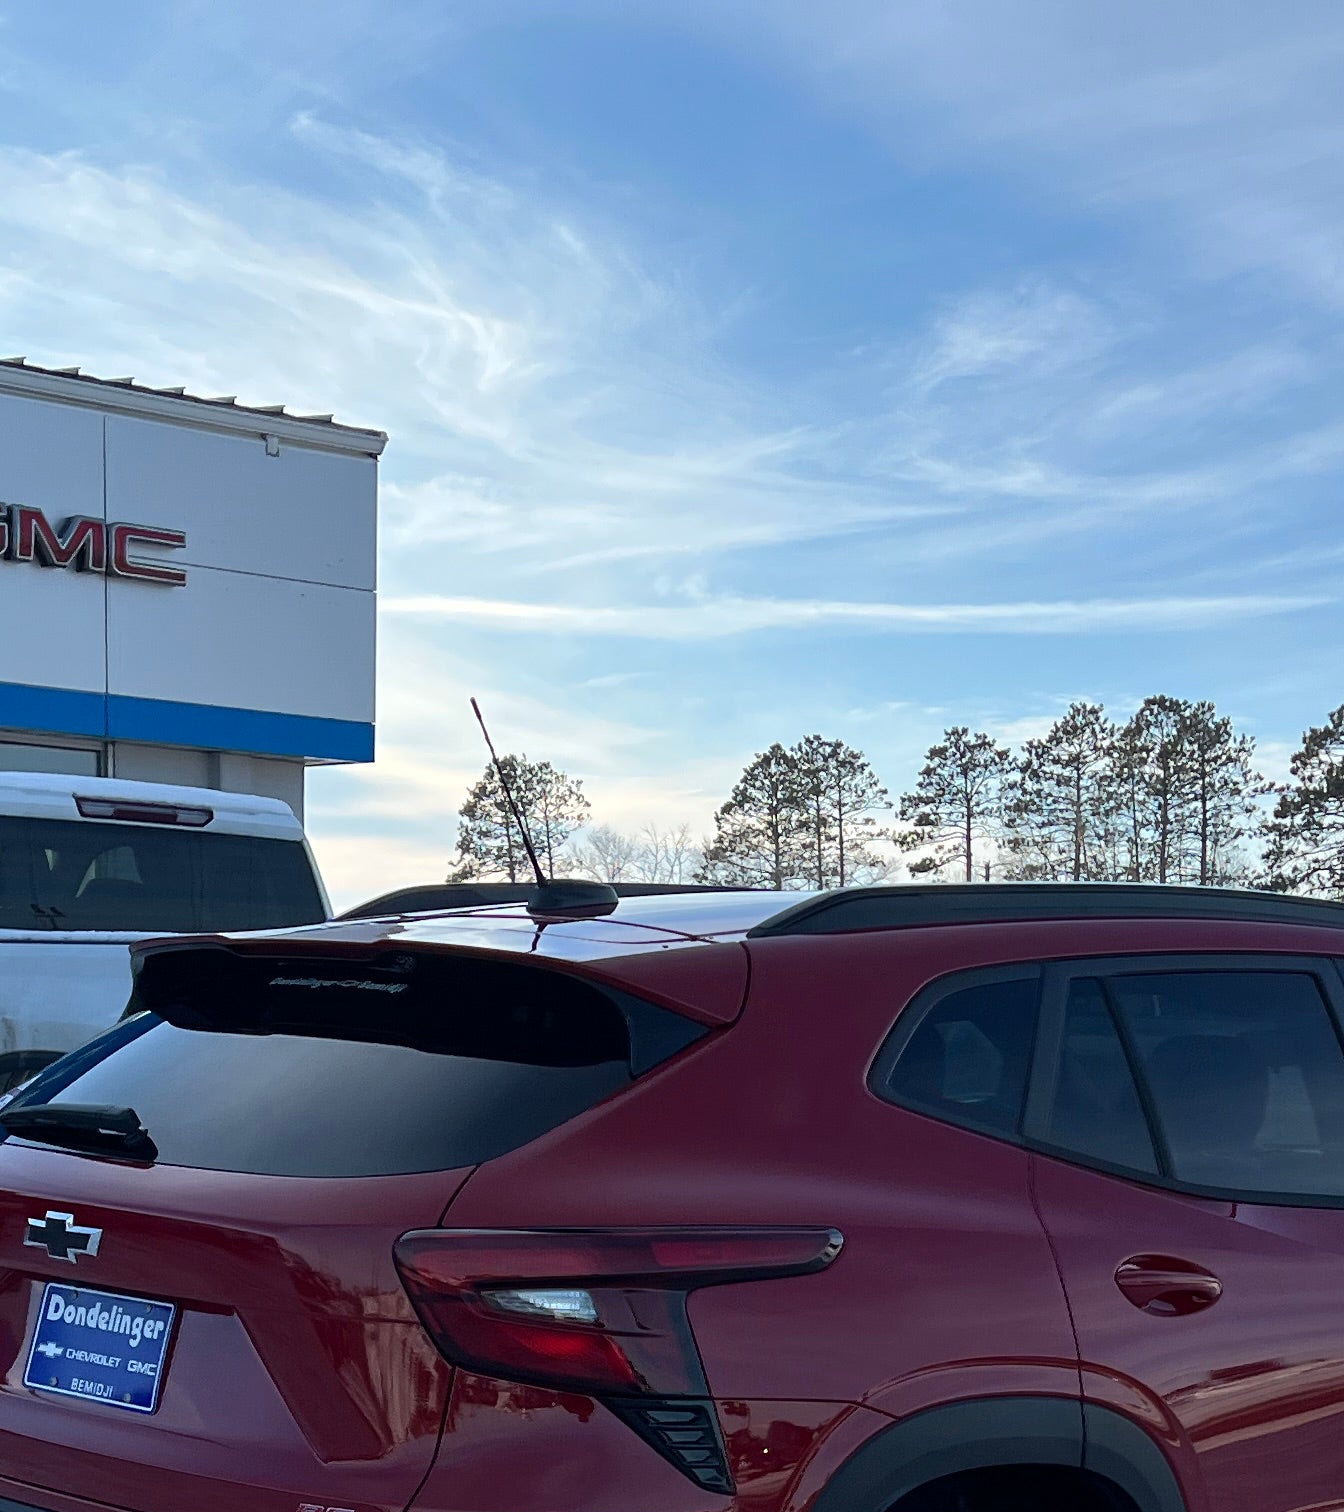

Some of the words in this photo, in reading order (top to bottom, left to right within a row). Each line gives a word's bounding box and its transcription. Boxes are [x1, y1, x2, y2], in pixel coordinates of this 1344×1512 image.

[46, 1293, 165, 1348] Dondelinger
[66, 1348, 122, 1368] CHEVROLET
[127, 1360, 158, 1376] GMC
[70, 1377, 114, 1398] BEMIDJI
